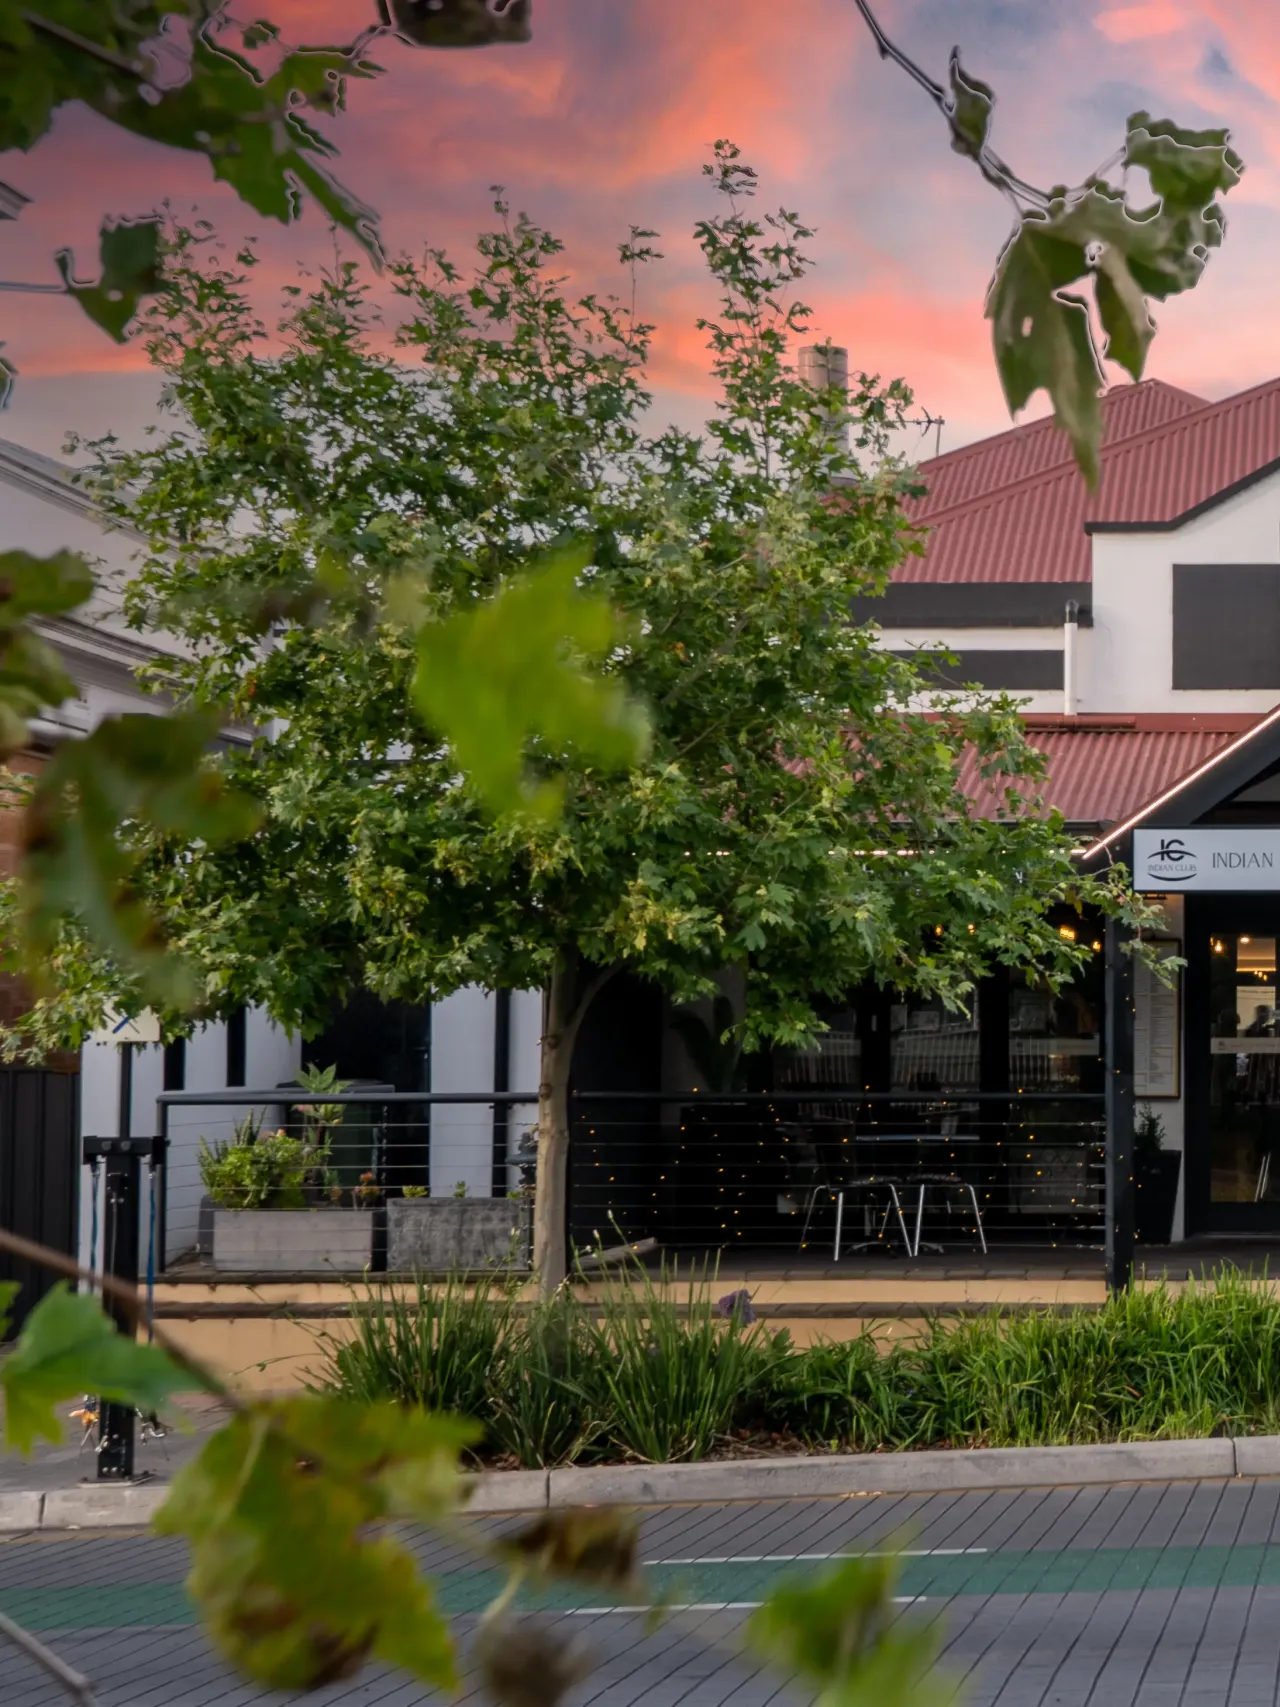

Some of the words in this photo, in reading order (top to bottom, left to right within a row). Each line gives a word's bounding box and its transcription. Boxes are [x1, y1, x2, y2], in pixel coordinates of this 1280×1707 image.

[1212, 852, 1273, 868] INDIAN
[1147, 864, 1174, 872] INDIAN
[1174, 864, 1197, 872] CLUB
